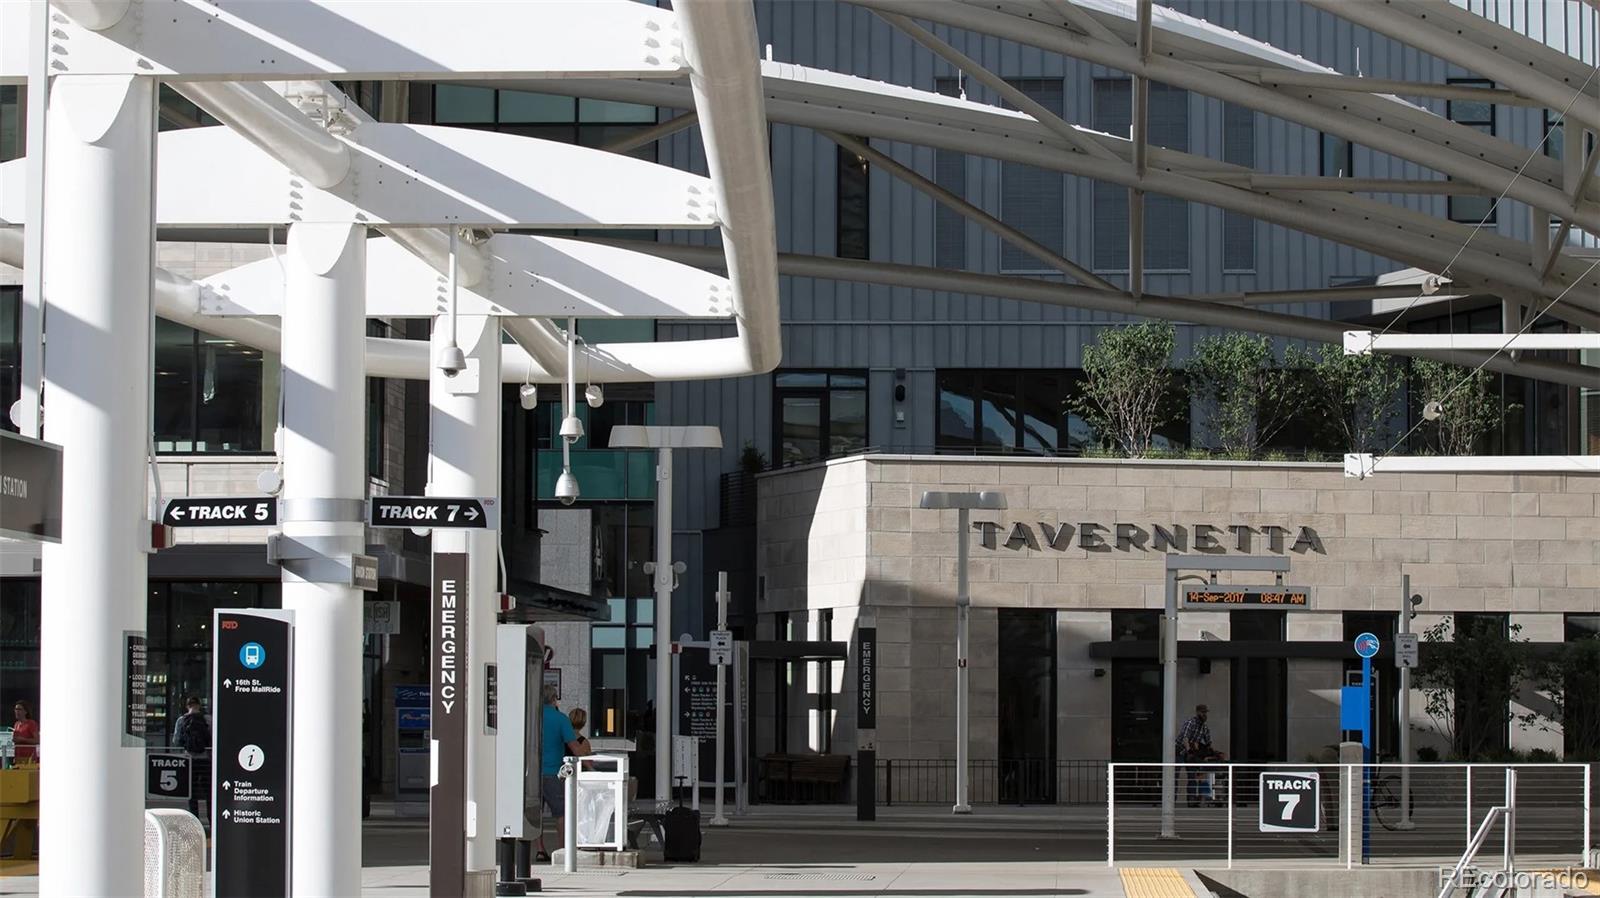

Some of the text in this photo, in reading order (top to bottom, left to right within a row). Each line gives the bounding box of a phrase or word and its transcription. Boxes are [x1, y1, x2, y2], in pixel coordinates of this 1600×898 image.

[3, 475, 28, 499] STATION
[189, 503, 269, 521] TRACK 5
[380, 504, 461, 522] TRACK 7
[973, 521, 1326, 555] TAVERNETTA
[1188, 592, 1305, 604] 14-Sep-2017 08:47 AM
[441, 580, 456, 714] EMERGENCY
[863, 642, 871, 715] EMERGENCY
[151, 759, 185, 767] TRACK
[160, 770, 178, 791] 5
[1266, 780, 1311, 790] TRACK
[1278, 794, 1300, 820] 7
